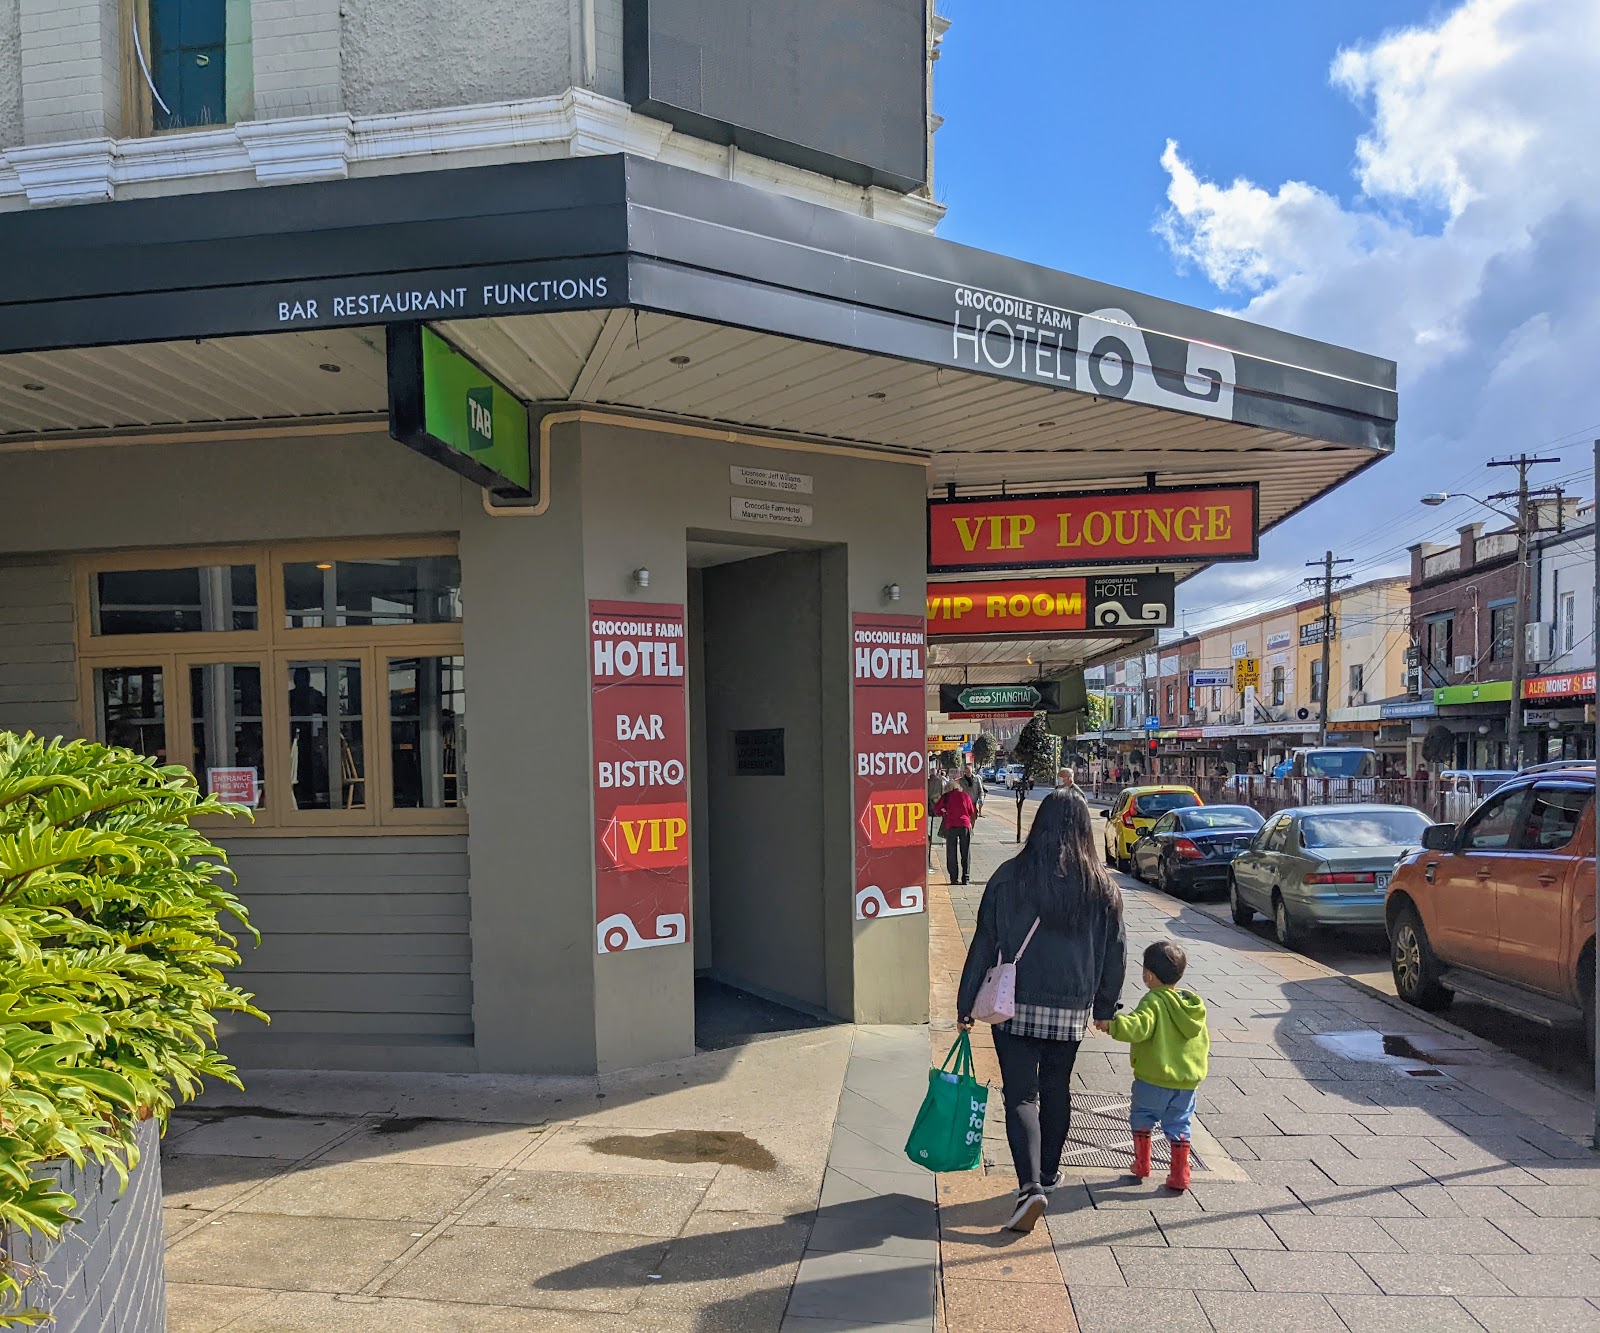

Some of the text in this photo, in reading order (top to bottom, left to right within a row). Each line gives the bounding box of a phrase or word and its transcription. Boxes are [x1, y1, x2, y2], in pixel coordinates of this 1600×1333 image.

[278, 276, 608, 322] BAR RESTAURANT FUNCTIONS
[954, 287, 1072, 331] CROCODILE FARM
[953, 309, 1071, 381] HOTEL
[468, 397, 492, 440] TAB
[952, 505, 1232, 552] VIP LOUNGE
[1094, 583, 1138, 597] HOTEL
[927, 592, 1082, 620] VIP ROOM
[592, 620, 684, 638] CROCODILE FARM
[854, 630, 924, 645] CROCODILE FARM
[593, 640, 684, 677] HOTEL
[855, 647, 924, 679] HOTEL
[991, 691, 1031, 704] SHANGHAI
[616, 714, 665, 741] BAR
[871, 712, 909, 735] BAR
[599, 759, 684, 788] BISTRO
[857, 751, 923, 776] BISTRO
[213, 774, 252, 783] ENTRANCE
[233, 781, 249, 789] WAY
[873, 802, 925, 834] VIP
[619, 817, 687, 854] VIP
